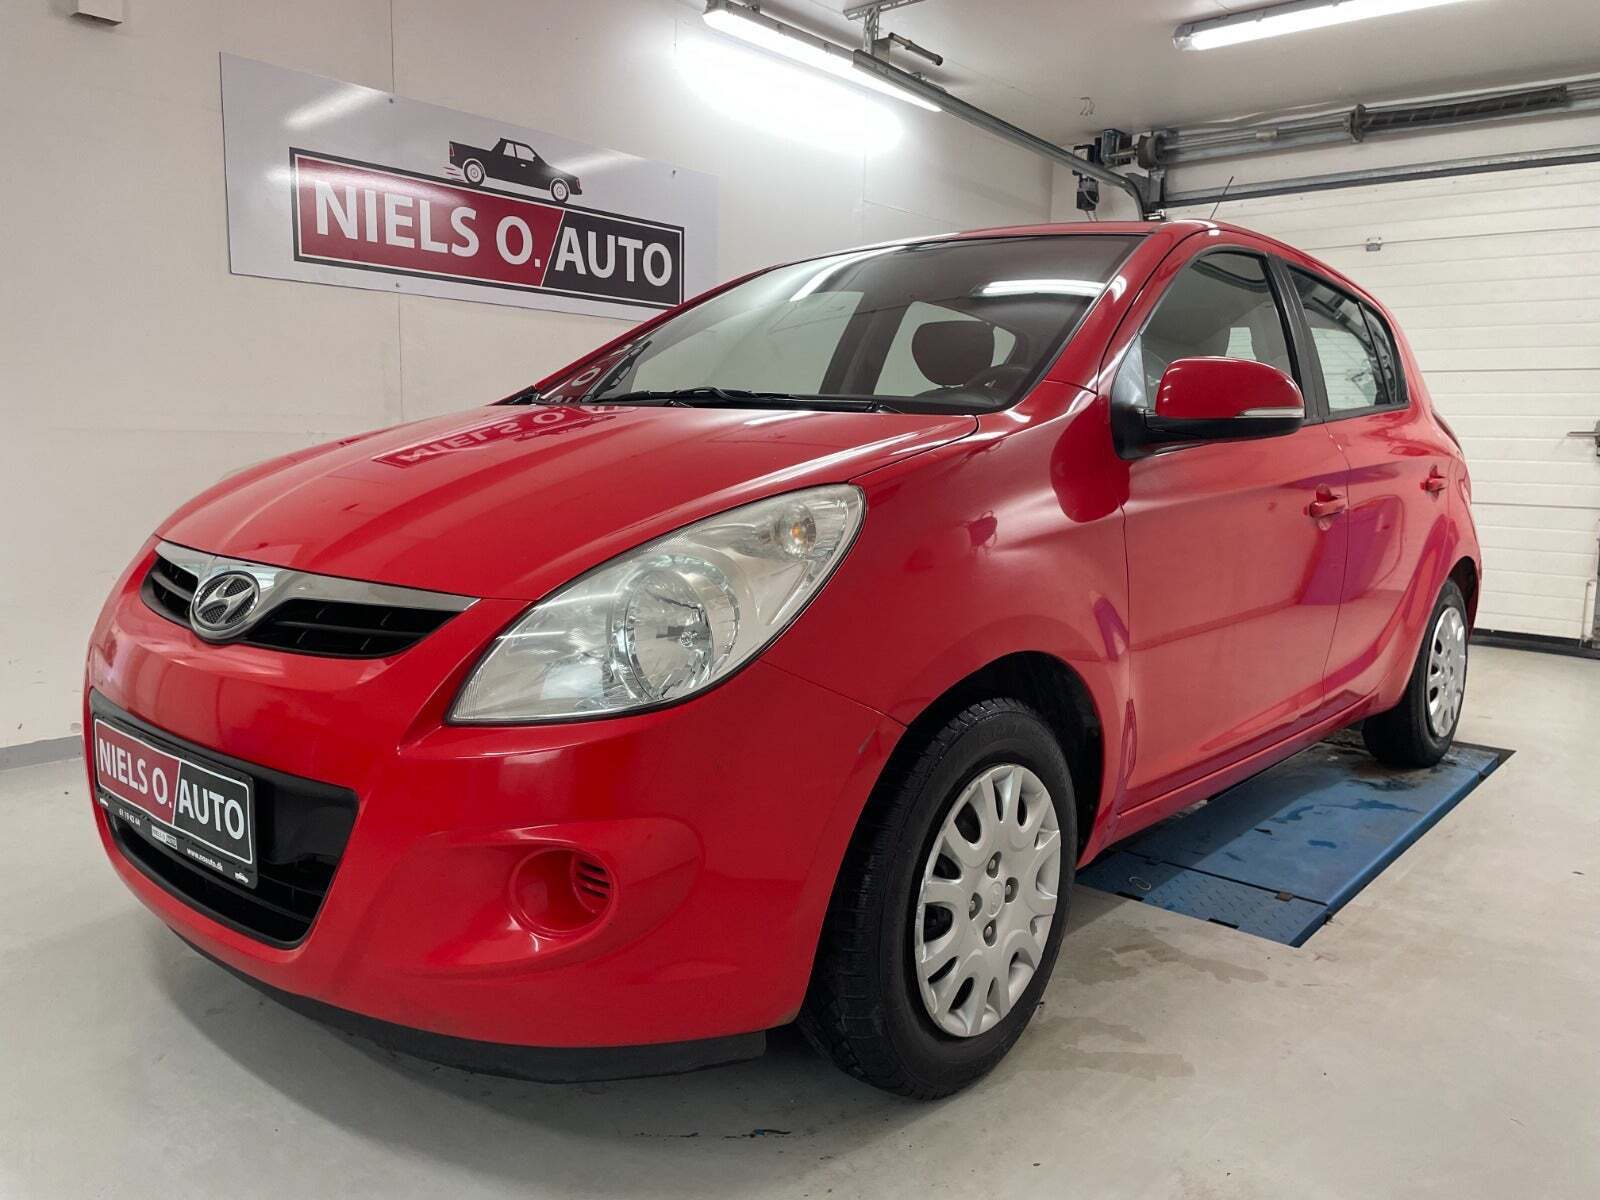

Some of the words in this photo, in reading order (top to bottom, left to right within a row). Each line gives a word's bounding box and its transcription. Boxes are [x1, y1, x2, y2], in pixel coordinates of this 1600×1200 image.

[314, 180, 480, 258] NIELS
[495, 215, 541, 268] O.
[554, 226, 673, 287] AUTO
[99, 738, 148, 795] NIELS
[152, 767, 172, 808] O.
[178, 778, 245, 840] AUTO
